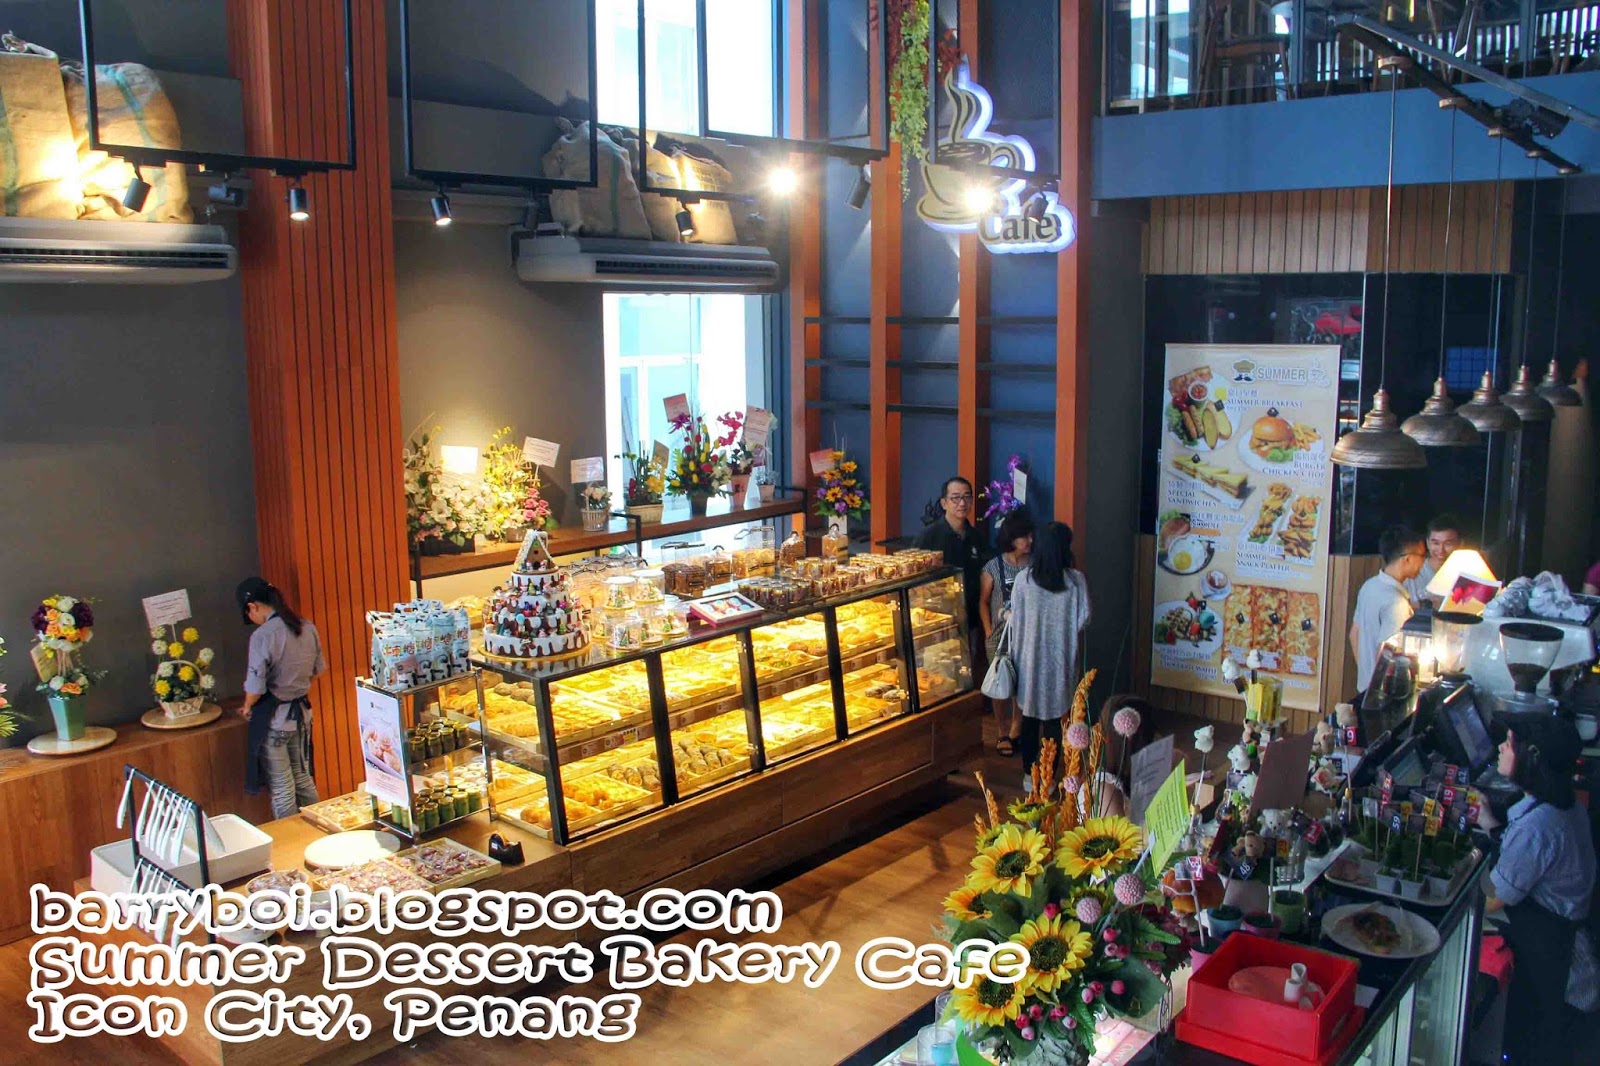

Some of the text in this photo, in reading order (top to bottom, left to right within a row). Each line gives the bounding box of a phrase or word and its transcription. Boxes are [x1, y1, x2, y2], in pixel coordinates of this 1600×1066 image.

[1257, 367, 1306, 381] SUMMER
[1227, 398, 1303, 408] SUMMER BREAKFAST
[1294, 460, 1325, 470] BURGER
[1346, 729, 1354, 742] 9
[1392, 815, 1401, 830] 59
[1239, 861, 1251, 875] 48
